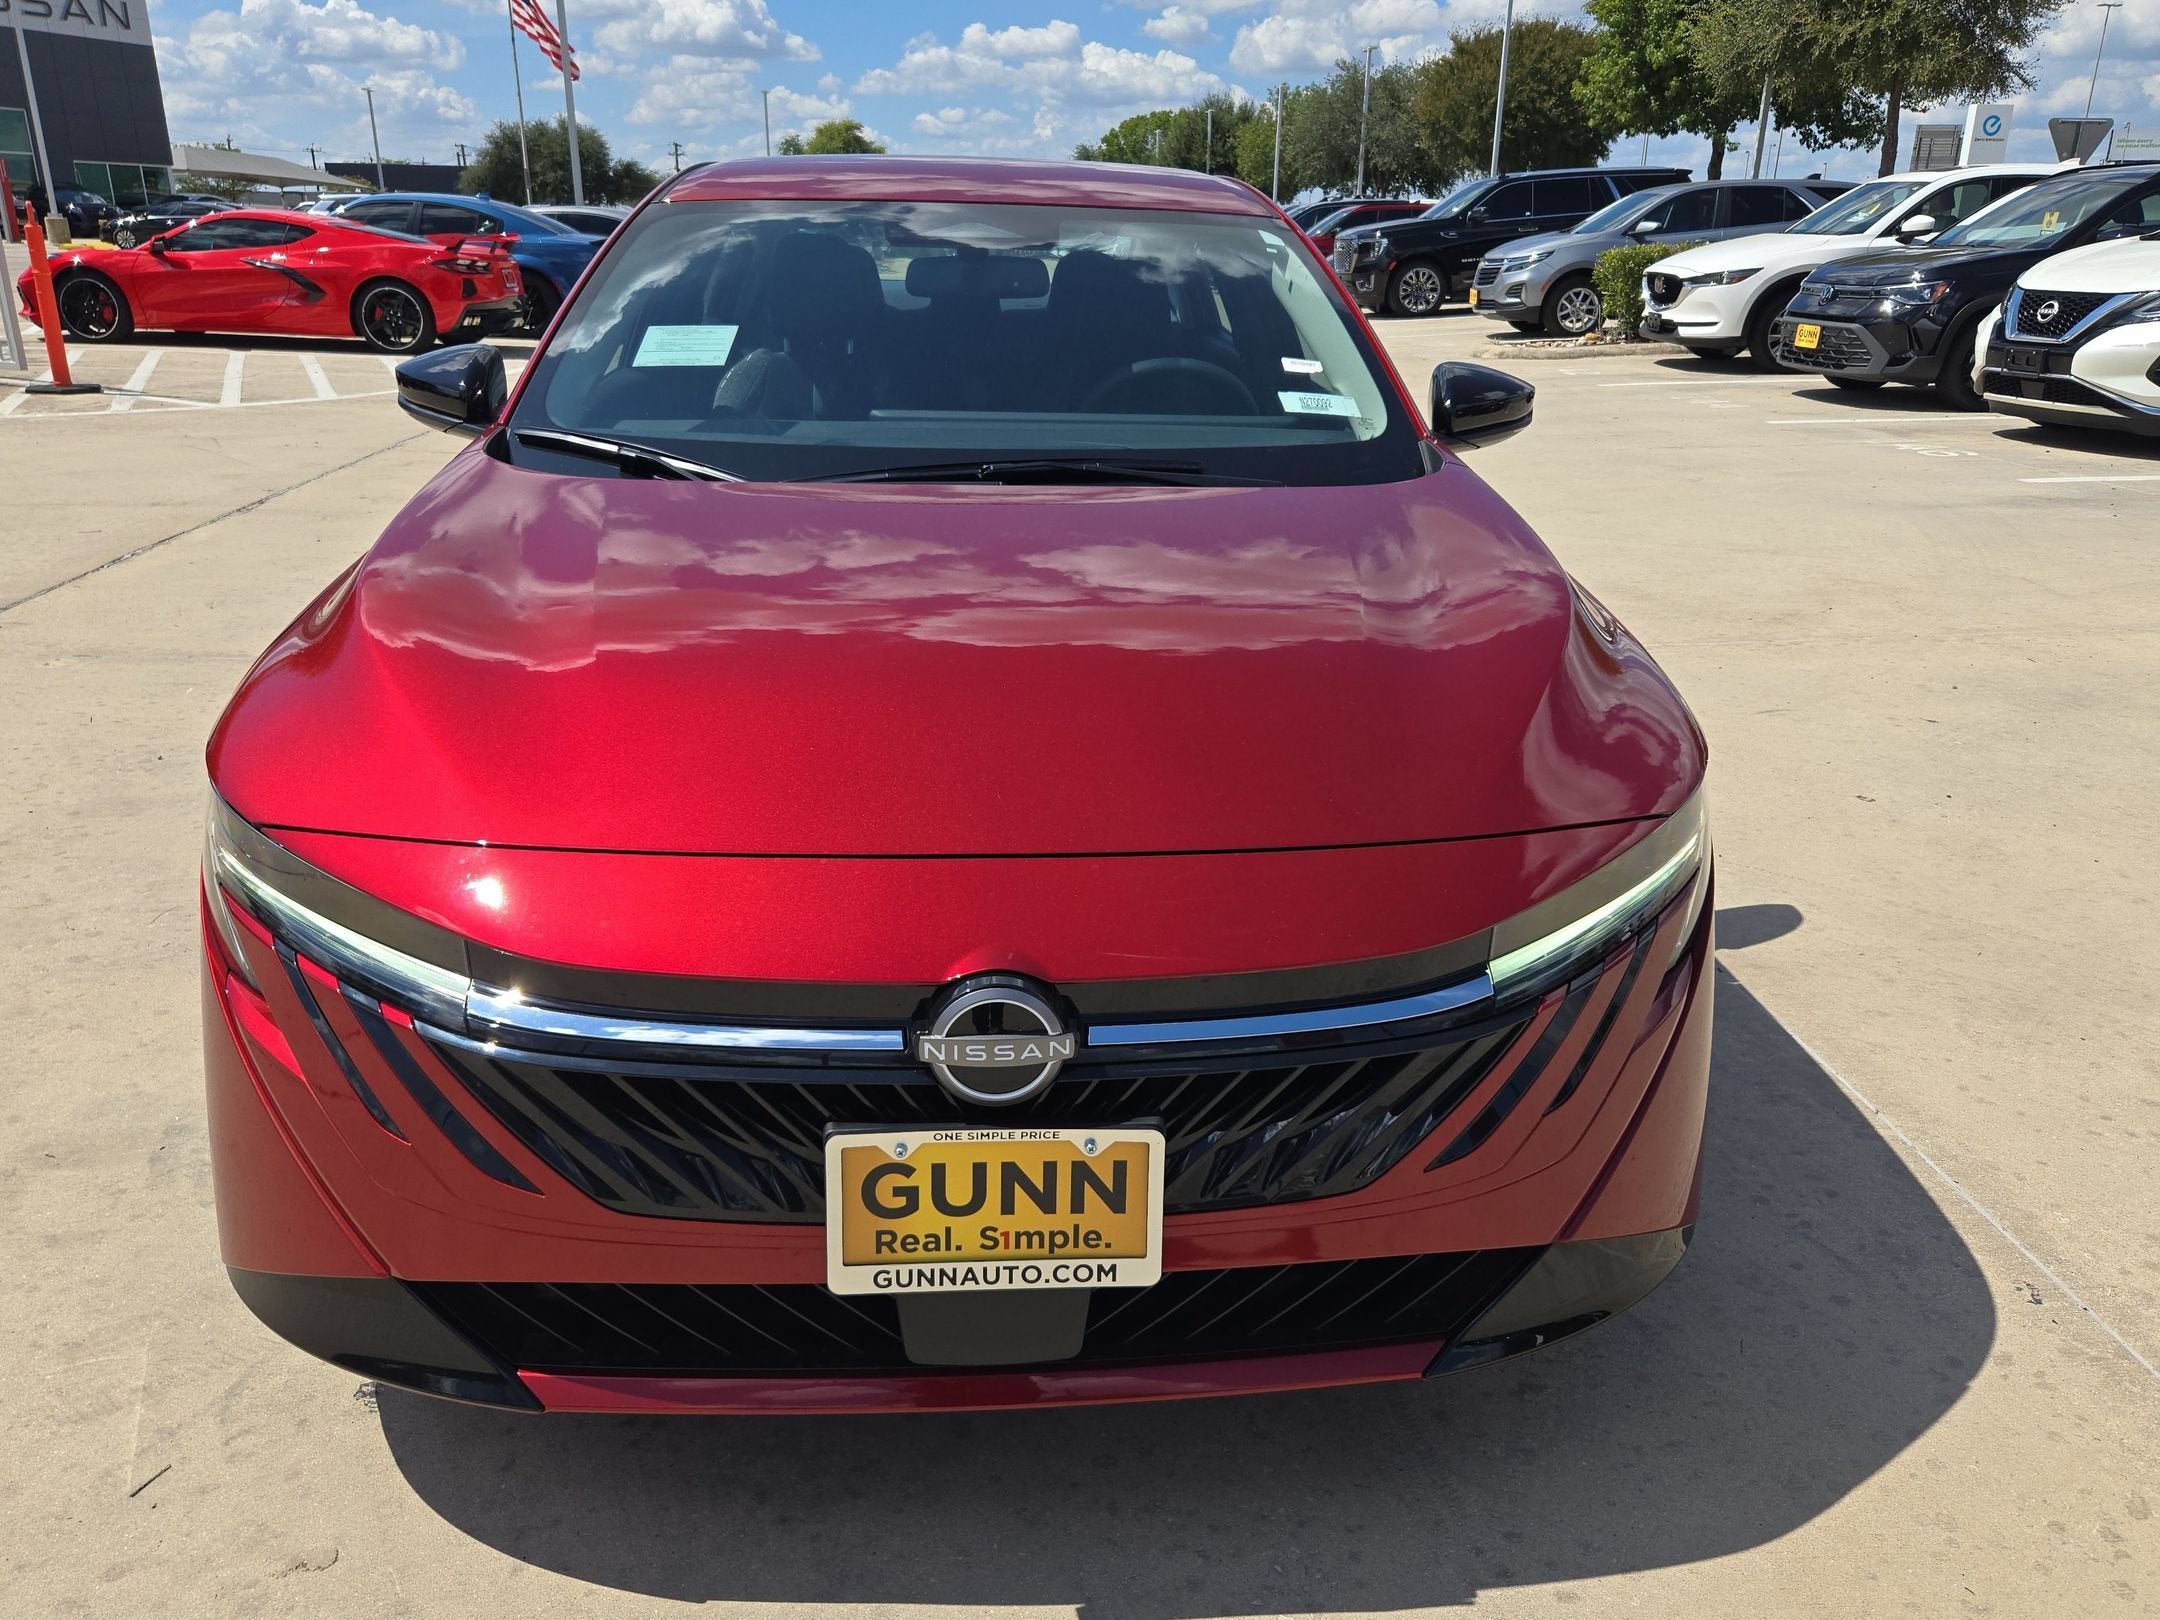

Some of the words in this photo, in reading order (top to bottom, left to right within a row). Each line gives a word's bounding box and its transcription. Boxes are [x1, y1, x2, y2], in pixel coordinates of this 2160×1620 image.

[1798, 329, 1818, 339] GUNN
[924, 1039, 1070, 1061] NISSAN
[933, 1132, 963, 1141] ONE
[967, 1131, 1016, 1140] SIMPLE
[1021, 1131, 1060, 1139] PRICE
[861, 1160, 1128, 1220] GUNN
[875, 1226, 962, 1254] Real.
[873, 1263, 1117, 1288] GUNNAUTO.COM
